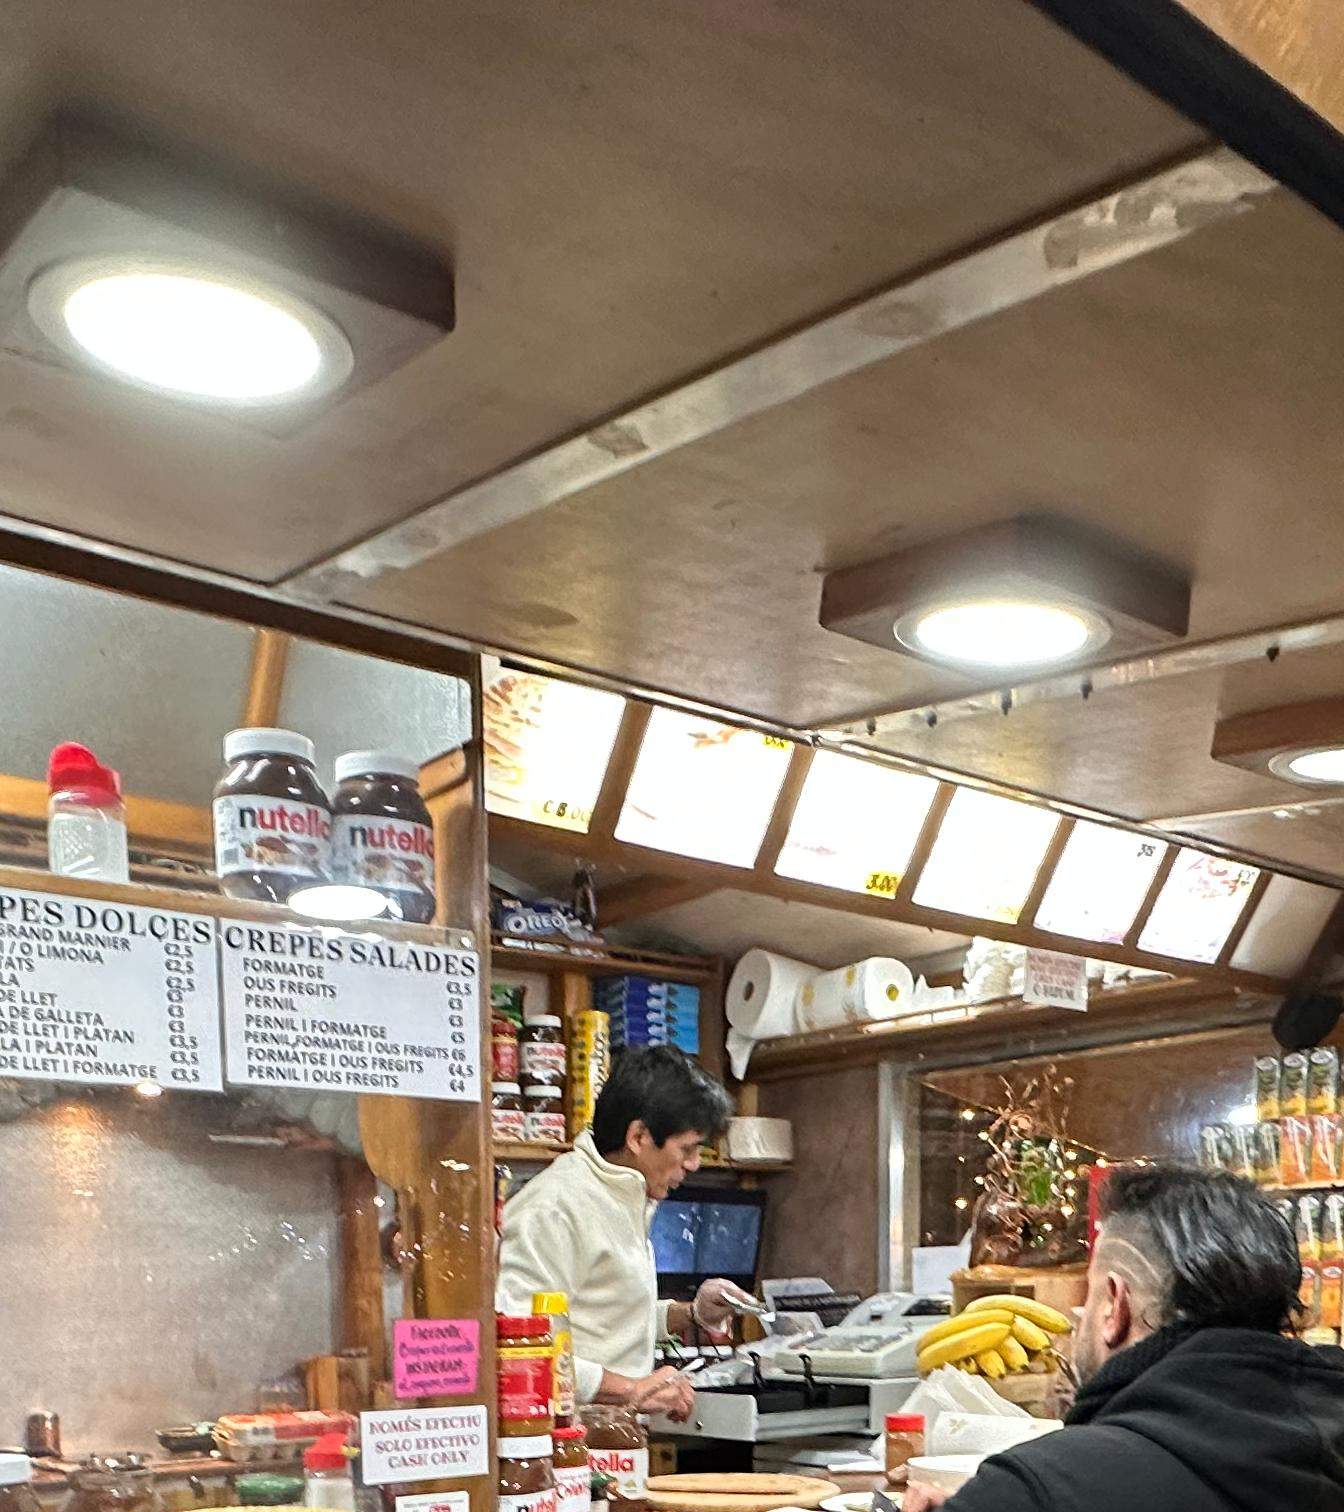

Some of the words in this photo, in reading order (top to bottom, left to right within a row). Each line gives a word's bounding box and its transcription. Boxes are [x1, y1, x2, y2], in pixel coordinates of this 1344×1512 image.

[75, 904, 212, 945] DOLÇES
[20, 941, 33, 957] O
[58, 930, 132, 952] MARNIER
[225, 926, 343, 961] CREPES
[350, 941, 475, 977] SALADES
[243, 957, 324, 979] FORMATGE
[243, 976, 276, 992] OUS
[279, 980, 336, 998] FREGITS
[20, 990, 58, 1007] LLET
[245, 994, 298, 1012] PERNIL
[9, 1006, 31, 1021] DE
[34, 1007, 104, 1026] GALLETA
[245, 1013, 298, 1032] PERNIL
[311, 1019, 387, 1039] FORMATGE
[23, 1022, 59, 1038] LLET
[73, 1026, 134, 1044] PLATAN
[35, 1040, 98, 1057] PLATAN
[375, 1041, 401, 1056] OUS
[403, 1044, 449, 1060] FREGITS
[23, 1056, 59, 1073] LLET
[73, 1060, 158, 1079] FORMATGE
[247, 1047, 327, 1066] FORMATGE
[339, 1054, 368, 1069] OUS
[372, 1056, 424, 1074] FREGITS
[247, 1064, 300, 1081] PERNIL
[312, 1069, 342, 1084] OUS
[345, 1072, 400, 1088] FREGITS
[369, 1416, 421, 1434] NOMÉS
[425, 1415, 481, 1430] EFECTIU
[375, 1439, 412, 1454] SOLO
[416, 1434, 480, 1450] EFECTIVO
[388, 1454, 428, 1469] CASH
[431, 1451, 470, 1466] ONLY
